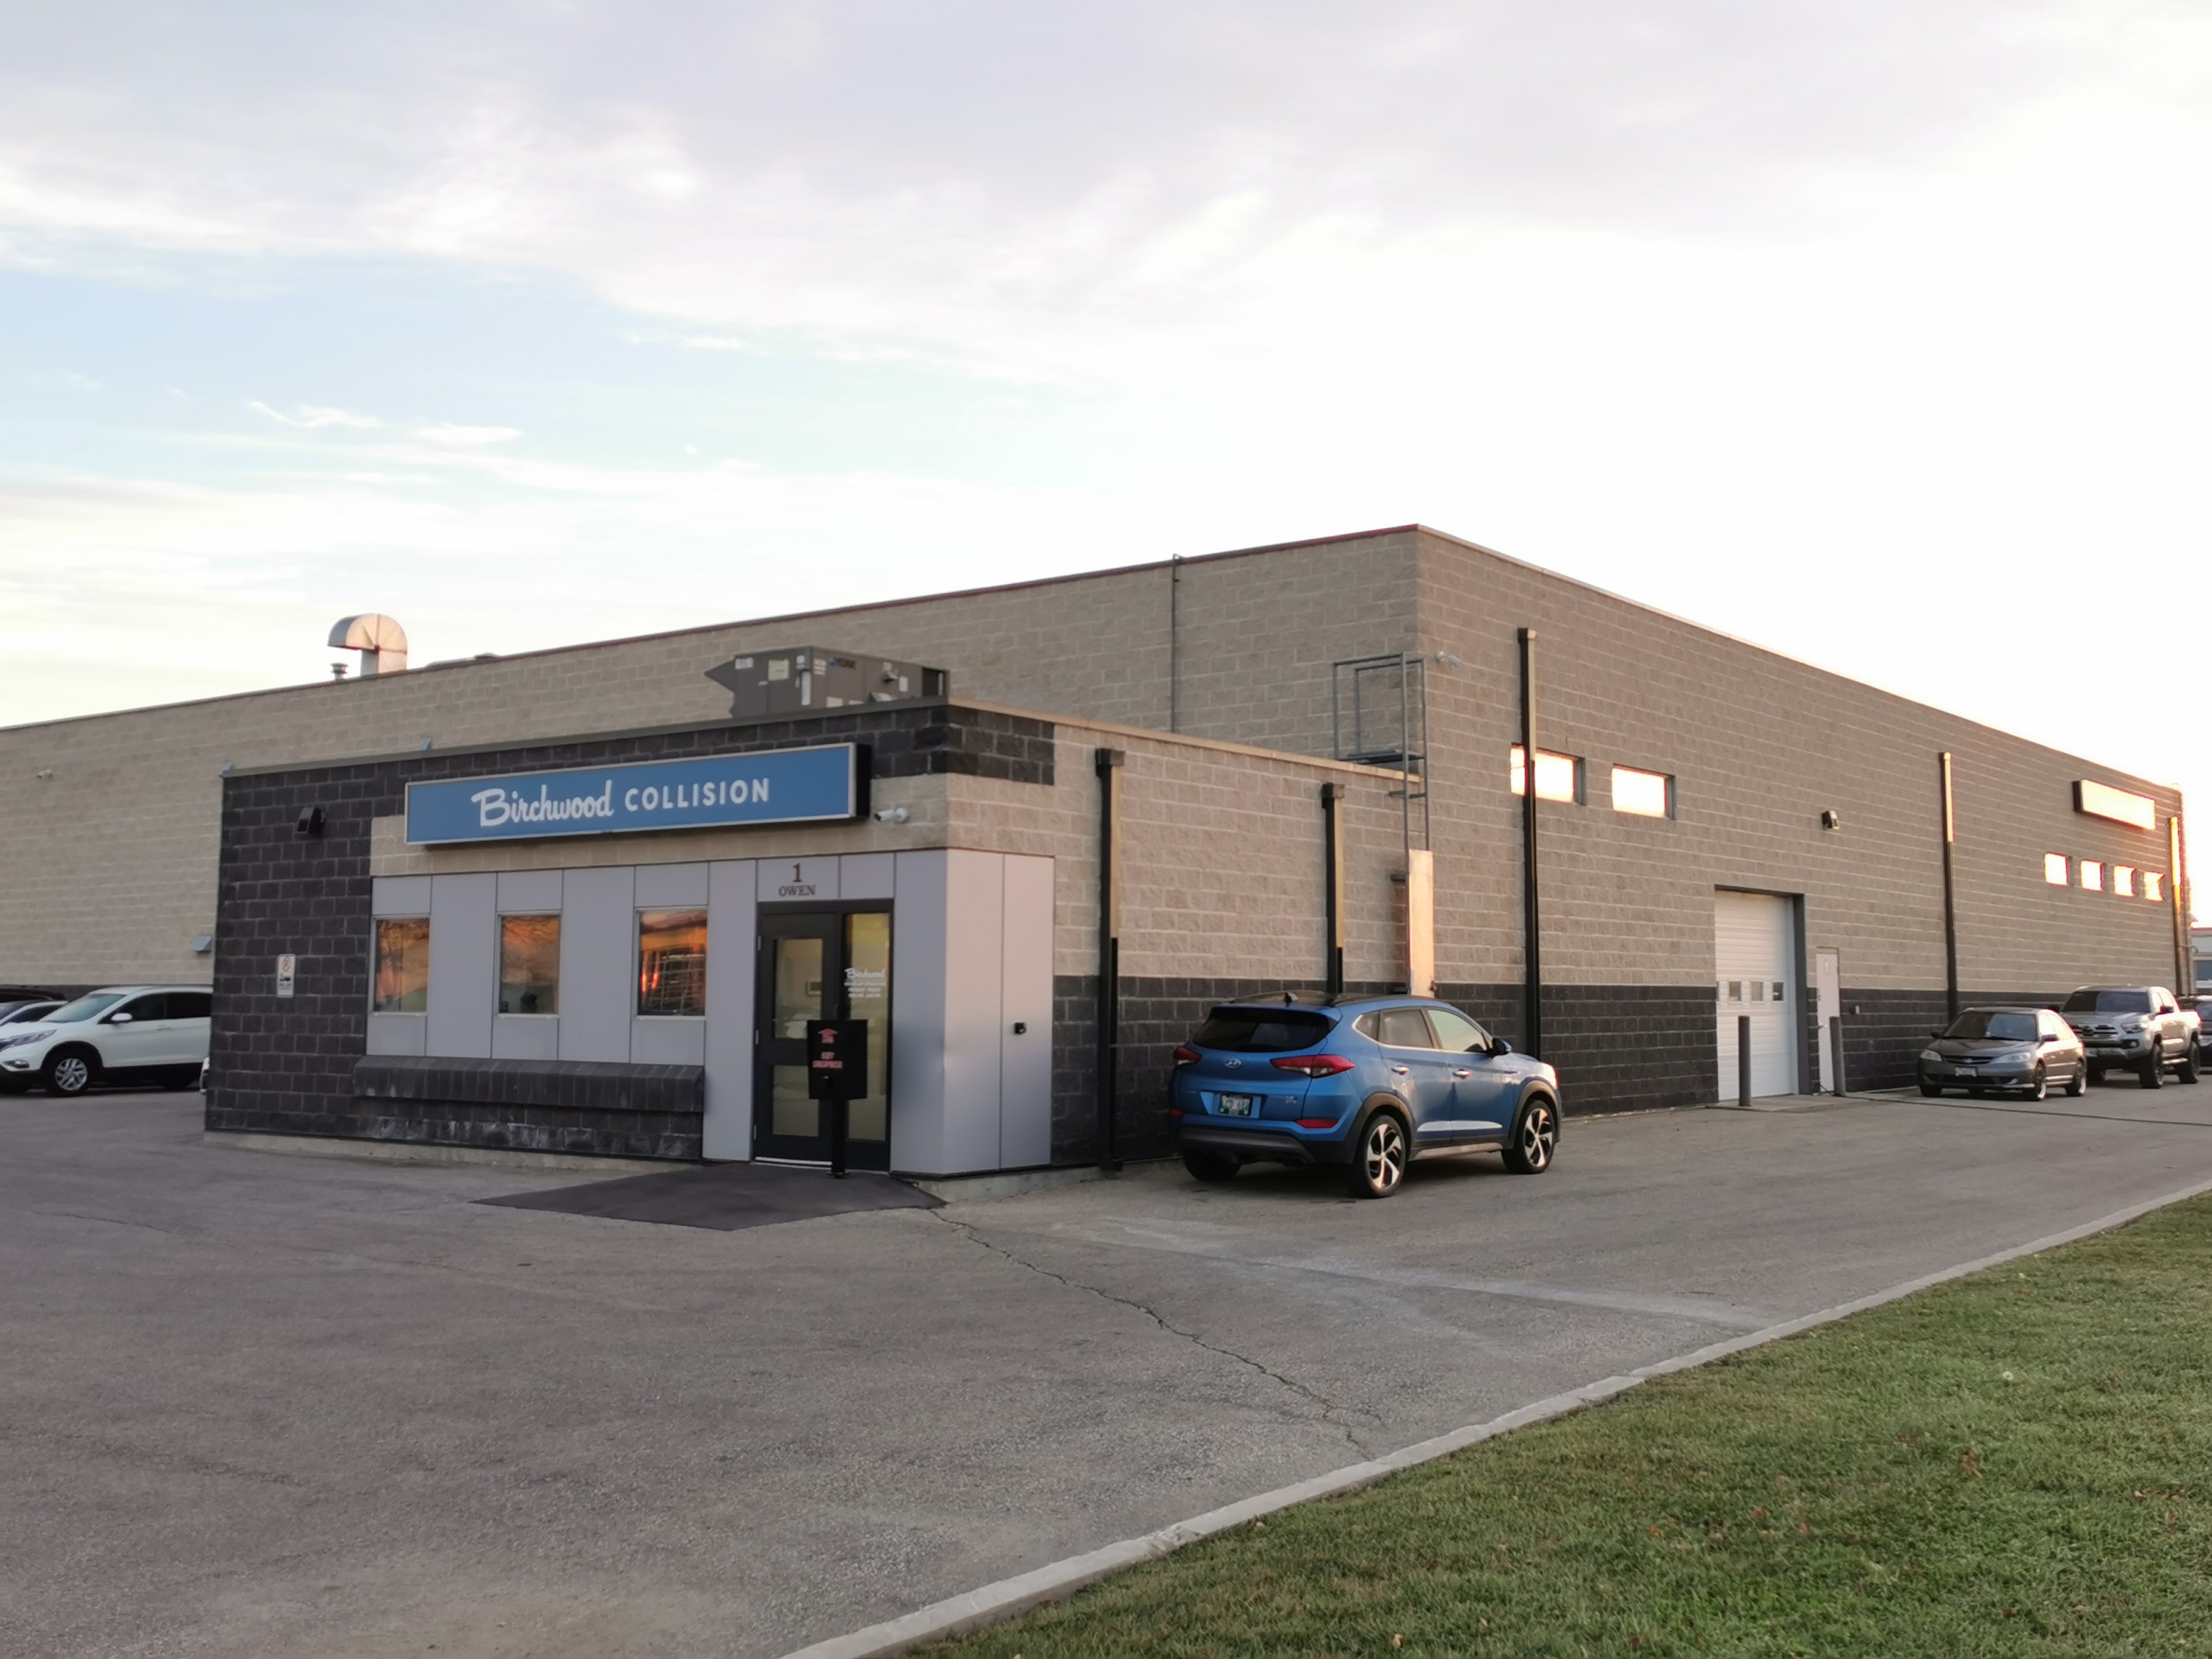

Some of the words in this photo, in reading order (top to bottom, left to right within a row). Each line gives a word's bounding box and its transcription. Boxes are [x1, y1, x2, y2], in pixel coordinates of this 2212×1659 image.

[471, 779, 614, 827] Birchwood
[625, 777, 770, 811] COLLISION
[792, 863, 803, 883] 1
[778, 884, 816, 897] OWEN
